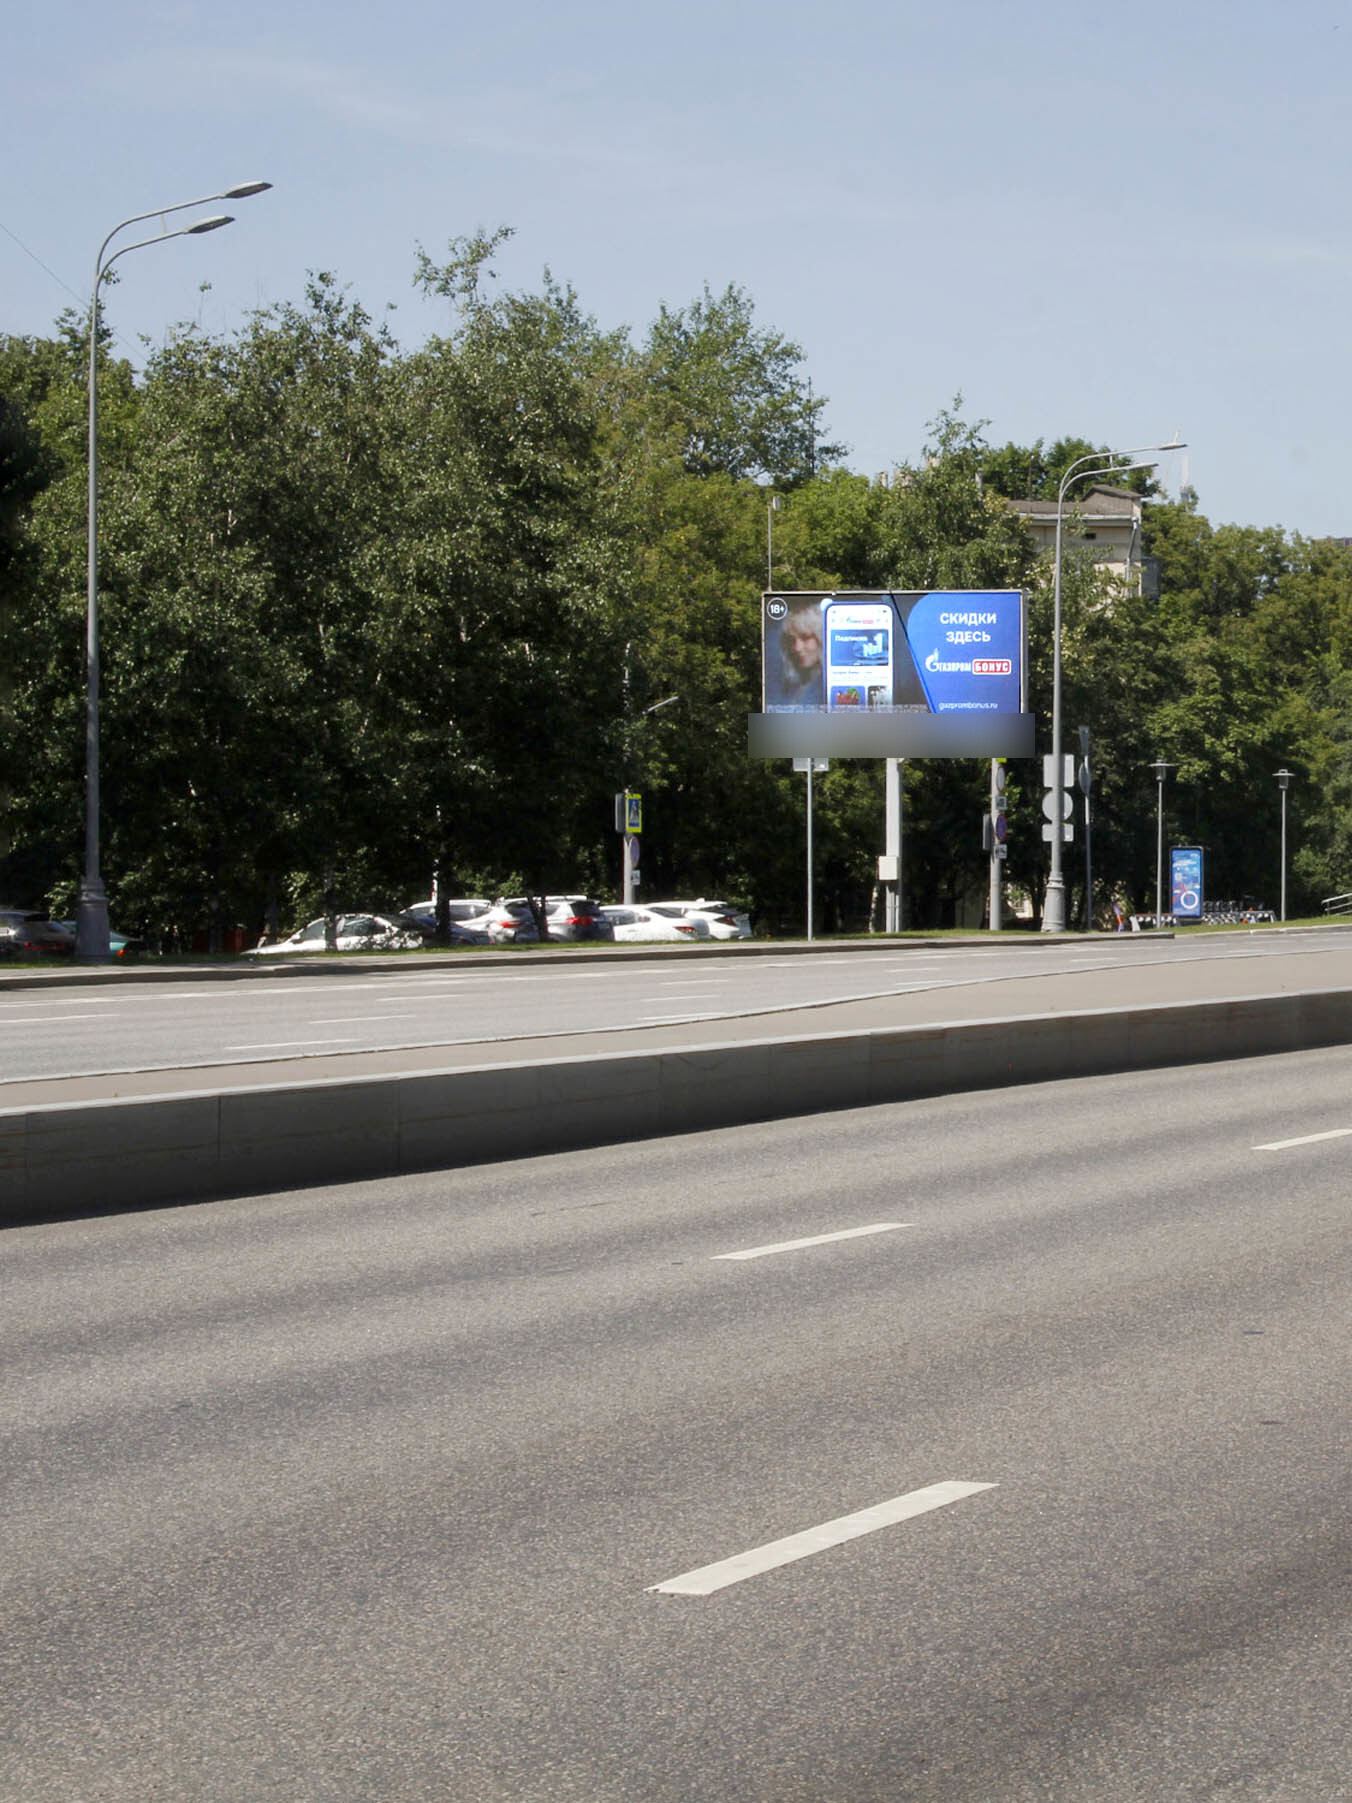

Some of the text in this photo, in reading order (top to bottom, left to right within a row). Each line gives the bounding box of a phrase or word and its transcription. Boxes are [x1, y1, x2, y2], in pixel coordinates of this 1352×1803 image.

[770, 604, 785, 614] 18+
[940, 612, 997, 626] СКИДКИ
[946, 631, 992, 644] ЗДЕСЬ
[975, 662, 1009, 672] БОНУС
[938, 702, 998, 712] gazprombonus.ru
